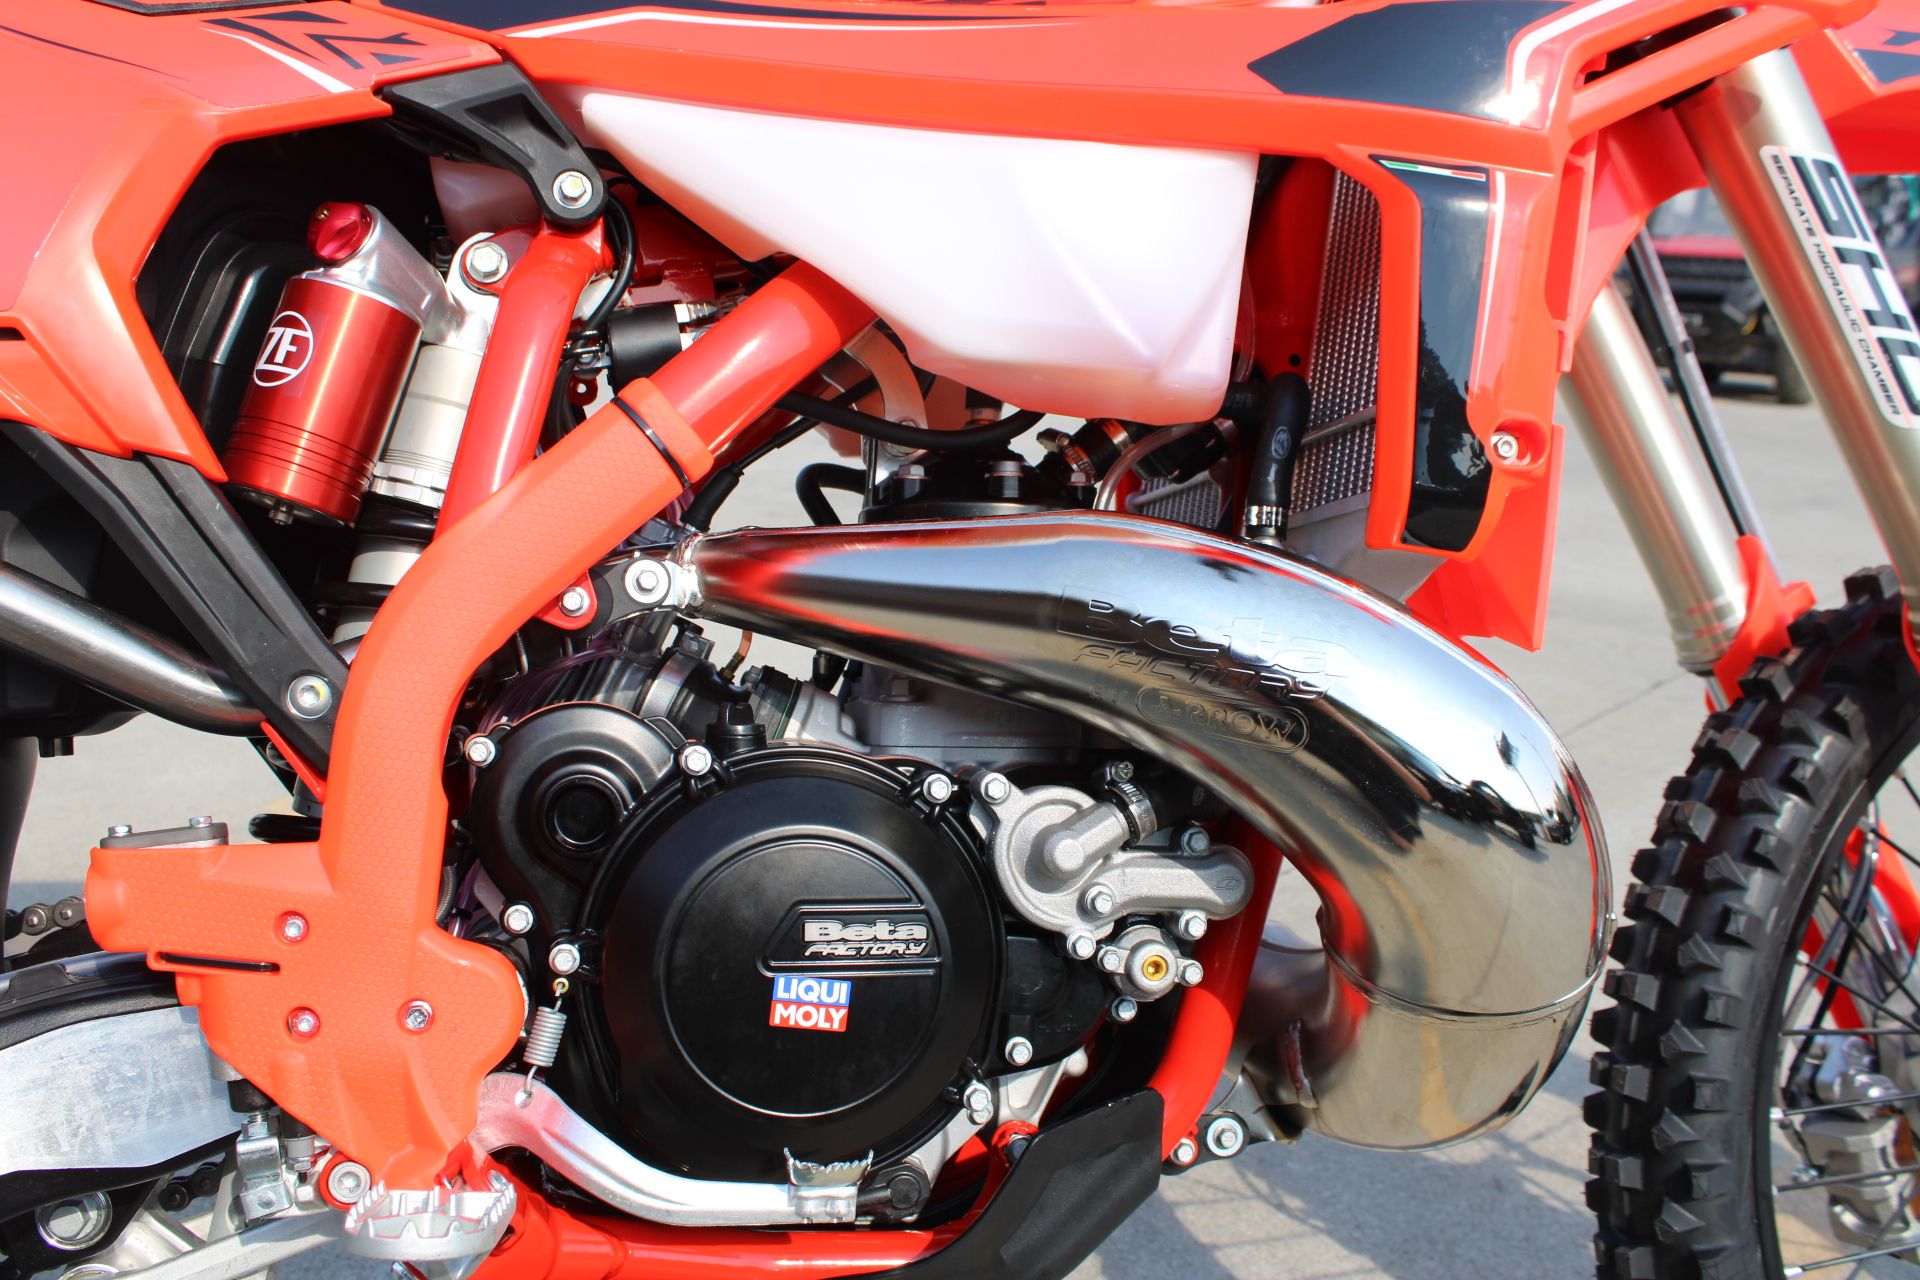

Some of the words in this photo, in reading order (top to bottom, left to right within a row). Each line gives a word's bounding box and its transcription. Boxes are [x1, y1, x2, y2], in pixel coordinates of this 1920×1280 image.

[1770, 154, 1817, 237] SEPARATE
[1813, 243, 1862, 333] HYDRAULIC
[1858, 338, 1901, 415] CHAMBER
[255, 326, 313, 375] ZF
[1056, 585, 1349, 678] Beta
[1150, 695, 1298, 742] ARROW
[804, 919, 929, 942] Beta
[804, 941, 928, 957] FACTORY
[776, 976, 848, 1004] LIQUI
[773, 1003, 848, 1030] MOLY
